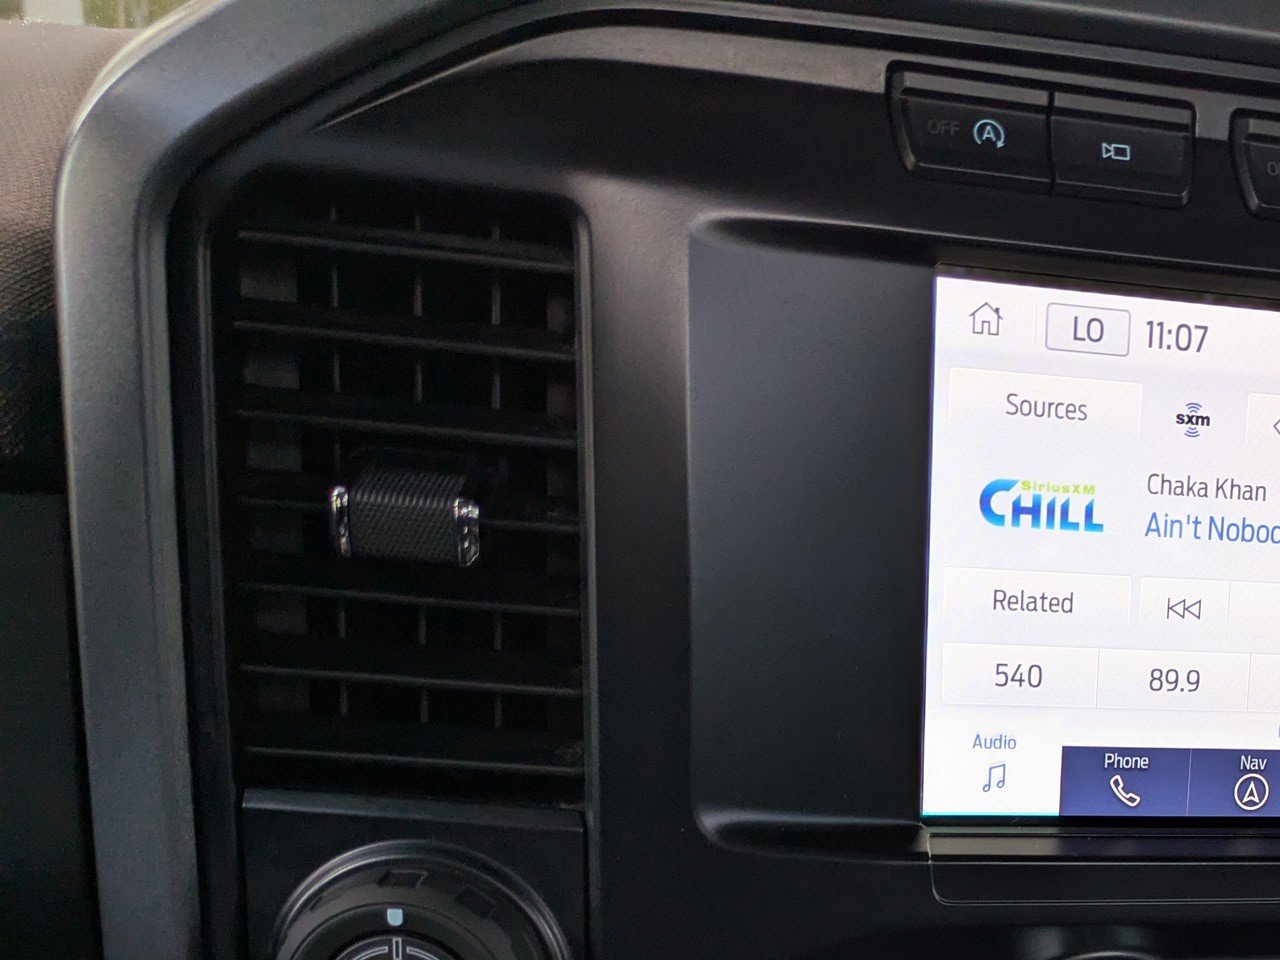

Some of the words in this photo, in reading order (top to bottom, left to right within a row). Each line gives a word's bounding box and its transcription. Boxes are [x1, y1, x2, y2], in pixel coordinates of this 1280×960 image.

[1072, 315, 1105, 343] LO
[1145, 320, 1209, 353] 11:07
[1005, 392, 1088, 421] Sources
[1175, 411, 1210, 428] sxm
[1020, 479, 1096, 496] SiriusXM
[1147, 473, 1209, 498] Chaka
[1214, 477, 1268, 502] Khan
[979, 478, 1104, 533] CHILL
[1144, 512, 1202, 541] Ain't
[992, 589, 1074, 614] Related
[994, 663, 1043, 688] 540
[1149, 668, 1201, 693] 89.9
[972, 732, 1017, 750] Audio
[1104, 753, 1149, 770] Phone
[1240, 755, 1267, 771] Nav
